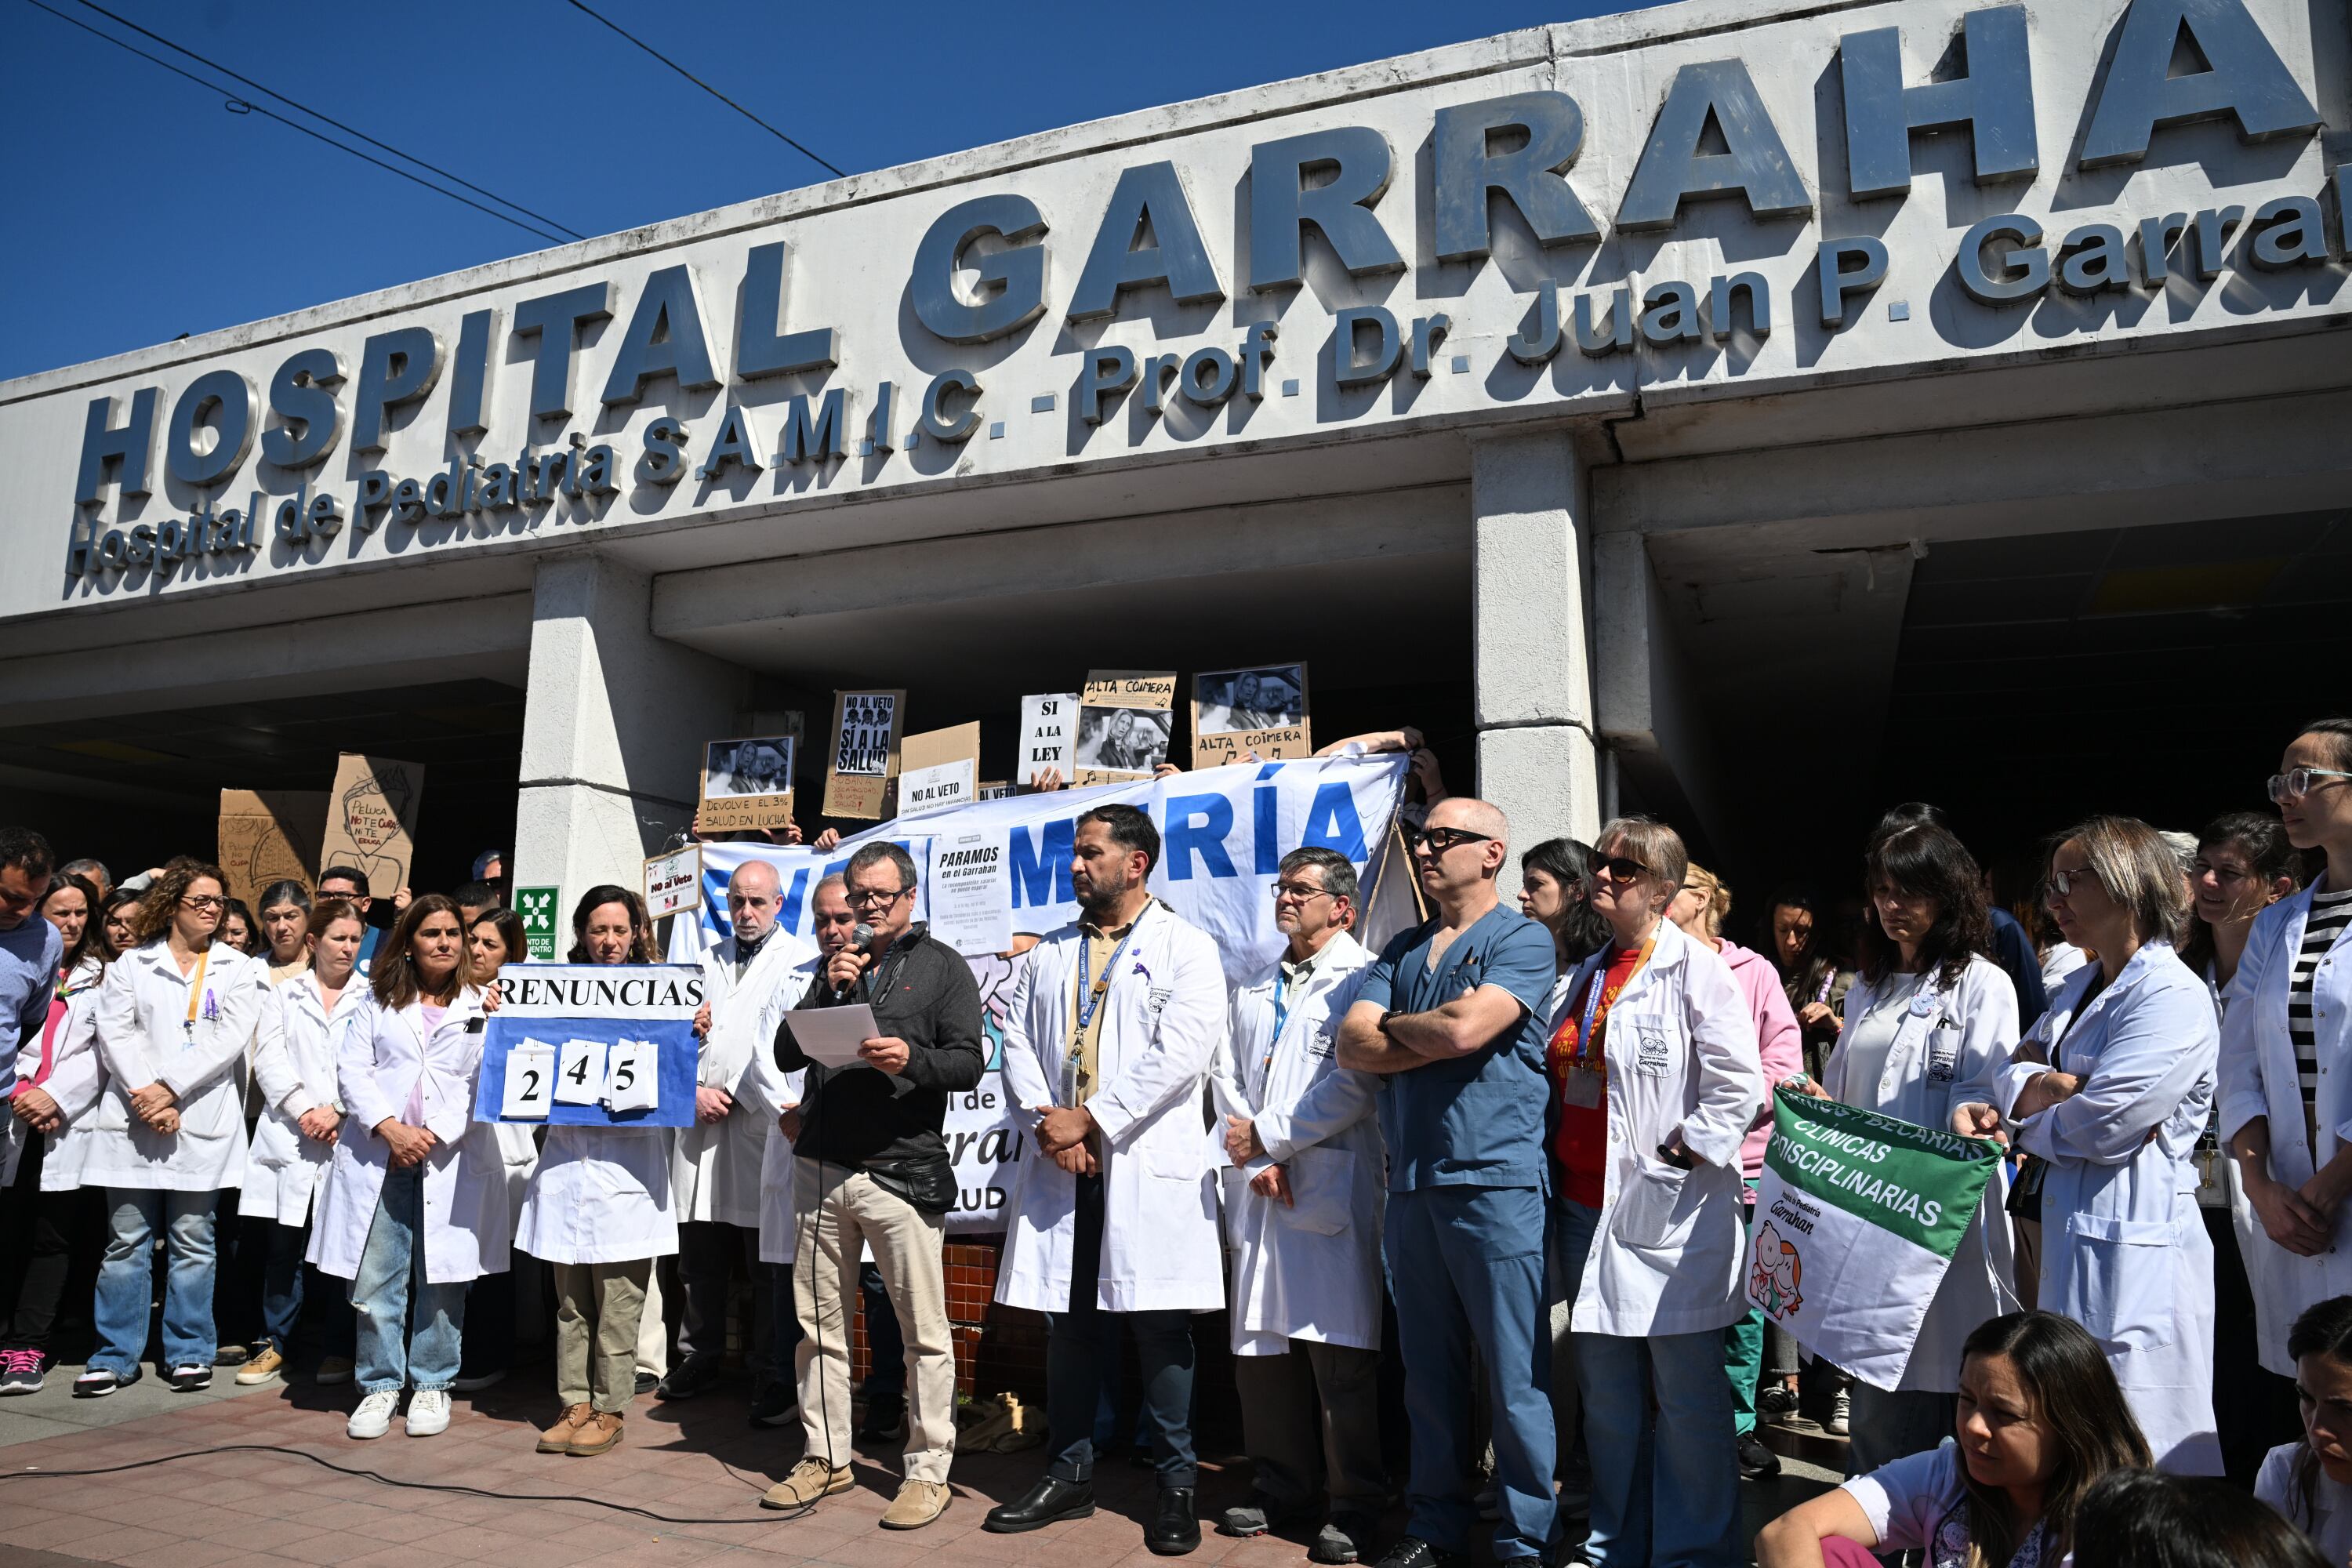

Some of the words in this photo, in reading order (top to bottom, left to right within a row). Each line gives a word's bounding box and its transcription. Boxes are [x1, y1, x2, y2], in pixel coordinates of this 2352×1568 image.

[66, 491, 269, 577] Hospital
[274, 483, 344, 542] de
[354, 432, 622, 532] Pediatria
[1081, 321, 1300, 426] Prof.
[1336, 306, 1470, 389] Dr.
[1507, 272, 1770, 366] Juan
[1819, 235, 1911, 328] P.
[1957, 163, 2352, 308] Garra
[74, 241, 838, 506] HOSPITAL
[1087, 680, 1117, 694] ALTA
[846, 697, 858, 709] NO
[859, 696, 870, 709] AL
[873, 696, 894, 710] VETO
[1041, 701, 1058, 716] SI
[841, 724, 855, 750] SÍ
[858, 729, 868, 750] A
[872, 730, 889, 750] LA
[1035, 727, 1043, 737] A
[1047, 726, 1061, 737] LA
[1200, 737, 1234, 751] ALTA
[838, 749, 887, 771] SALUD
[1032, 746, 1062, 762] LEY
[912, 789, 924, 802] NO
[925, 787, 935, 800] AL
[938, 782, 960, 797] VETO
[993, 787, 1016, 800] VETO
[706, 800, 750, 811] DEVOLVE
[773, 797, 788, 807] 3%
[946, 796, 971, 805] INFANCIAS
[364, 817, 377, 828] TE
[706, 815, 736, 826] SALUD
[739, 815, 753, 825] EN
[758, 813, 786, 826] LUCHA
[365, 828, 377, 837] TE
[939, 847, 1000, 868] PARAMOS
[942, 869, 951, 879] en
[953, 868, 960, 877] el
[963, 865, 996, 877] Garrahan
[651, 882, 662, 894] NO
[664, 878, 672, 889] al
[673, 874, 692, 886] Veto
[498, 978, 703, 1007] RENUNCIAS
[1639, 1058, 1668, 1067] Garrahan
[964, 1088, 996, 1111] de
[1794, 1120, 1892, 1163] CLÍNICAS
[1795, 1199, 1821, 1218] Pediatría
[1770, 1200, 1814, 1236] Garrahan
